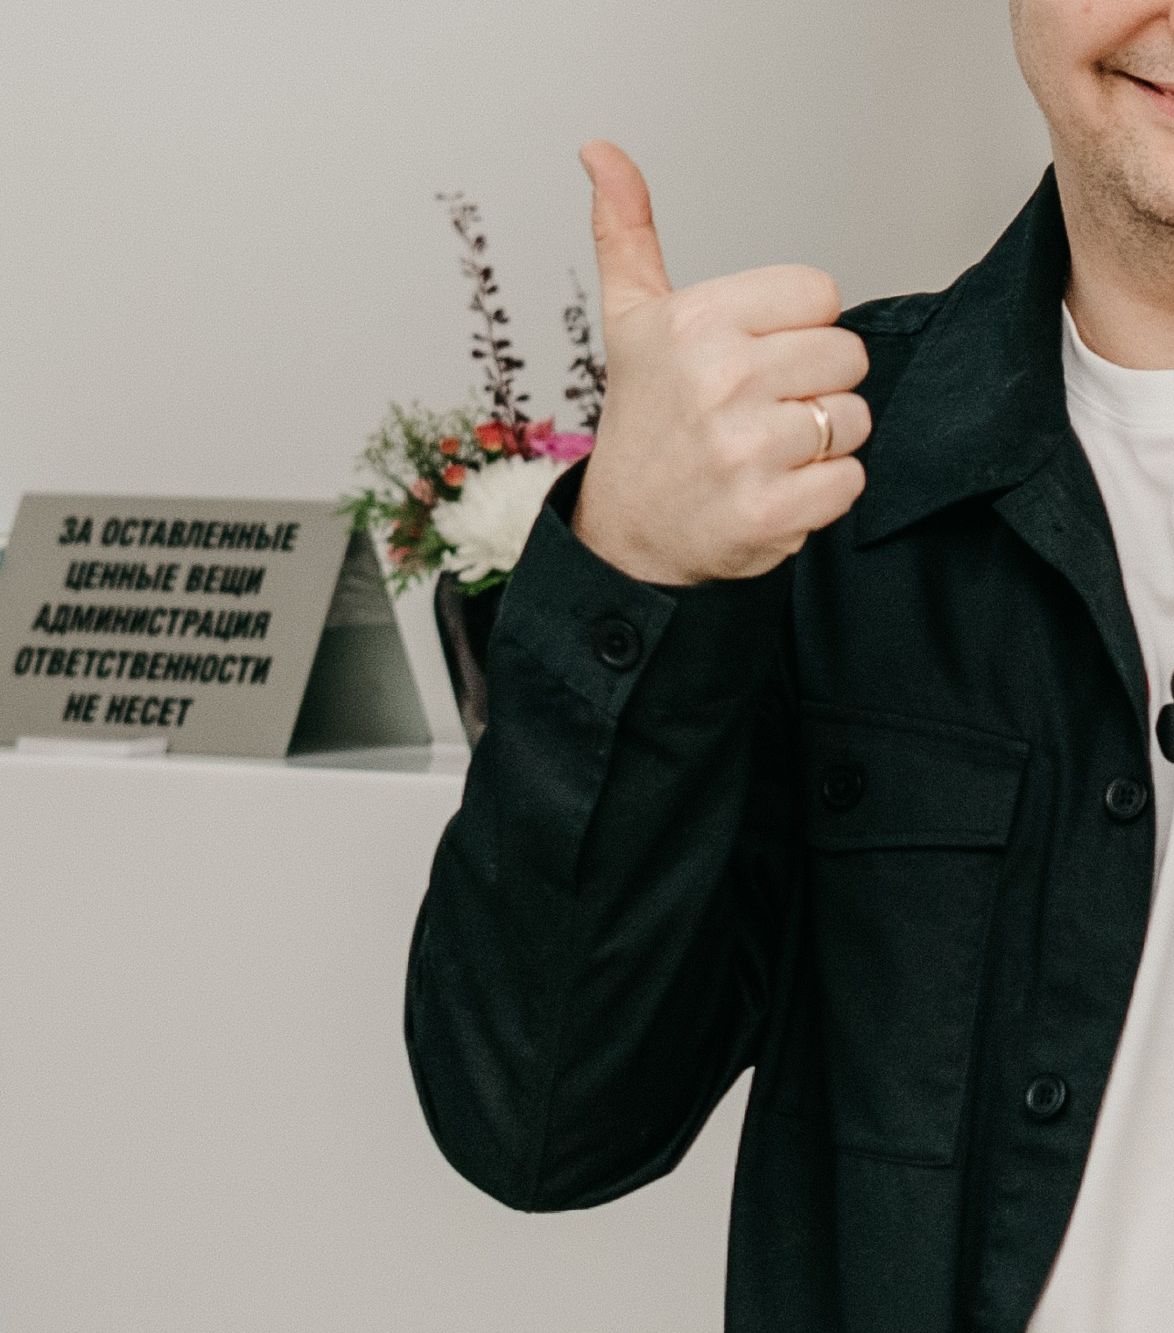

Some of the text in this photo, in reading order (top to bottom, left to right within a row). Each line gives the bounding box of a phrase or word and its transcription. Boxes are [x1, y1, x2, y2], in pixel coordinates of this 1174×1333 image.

[59, 516, 300, 552] ЗА ОСТАВЛЕННЫЕ
[65, 560, 267, 597] ЦЕННЫЕ ВЕЩИ
[31, 603, 272, 642] АДМИНИСТРАЦИЯ
[13, 645, 273, 685] ОТВЕТСТВЕННОСТИ
[62, 692, 194, 727] НЕ НЕСЕТ
